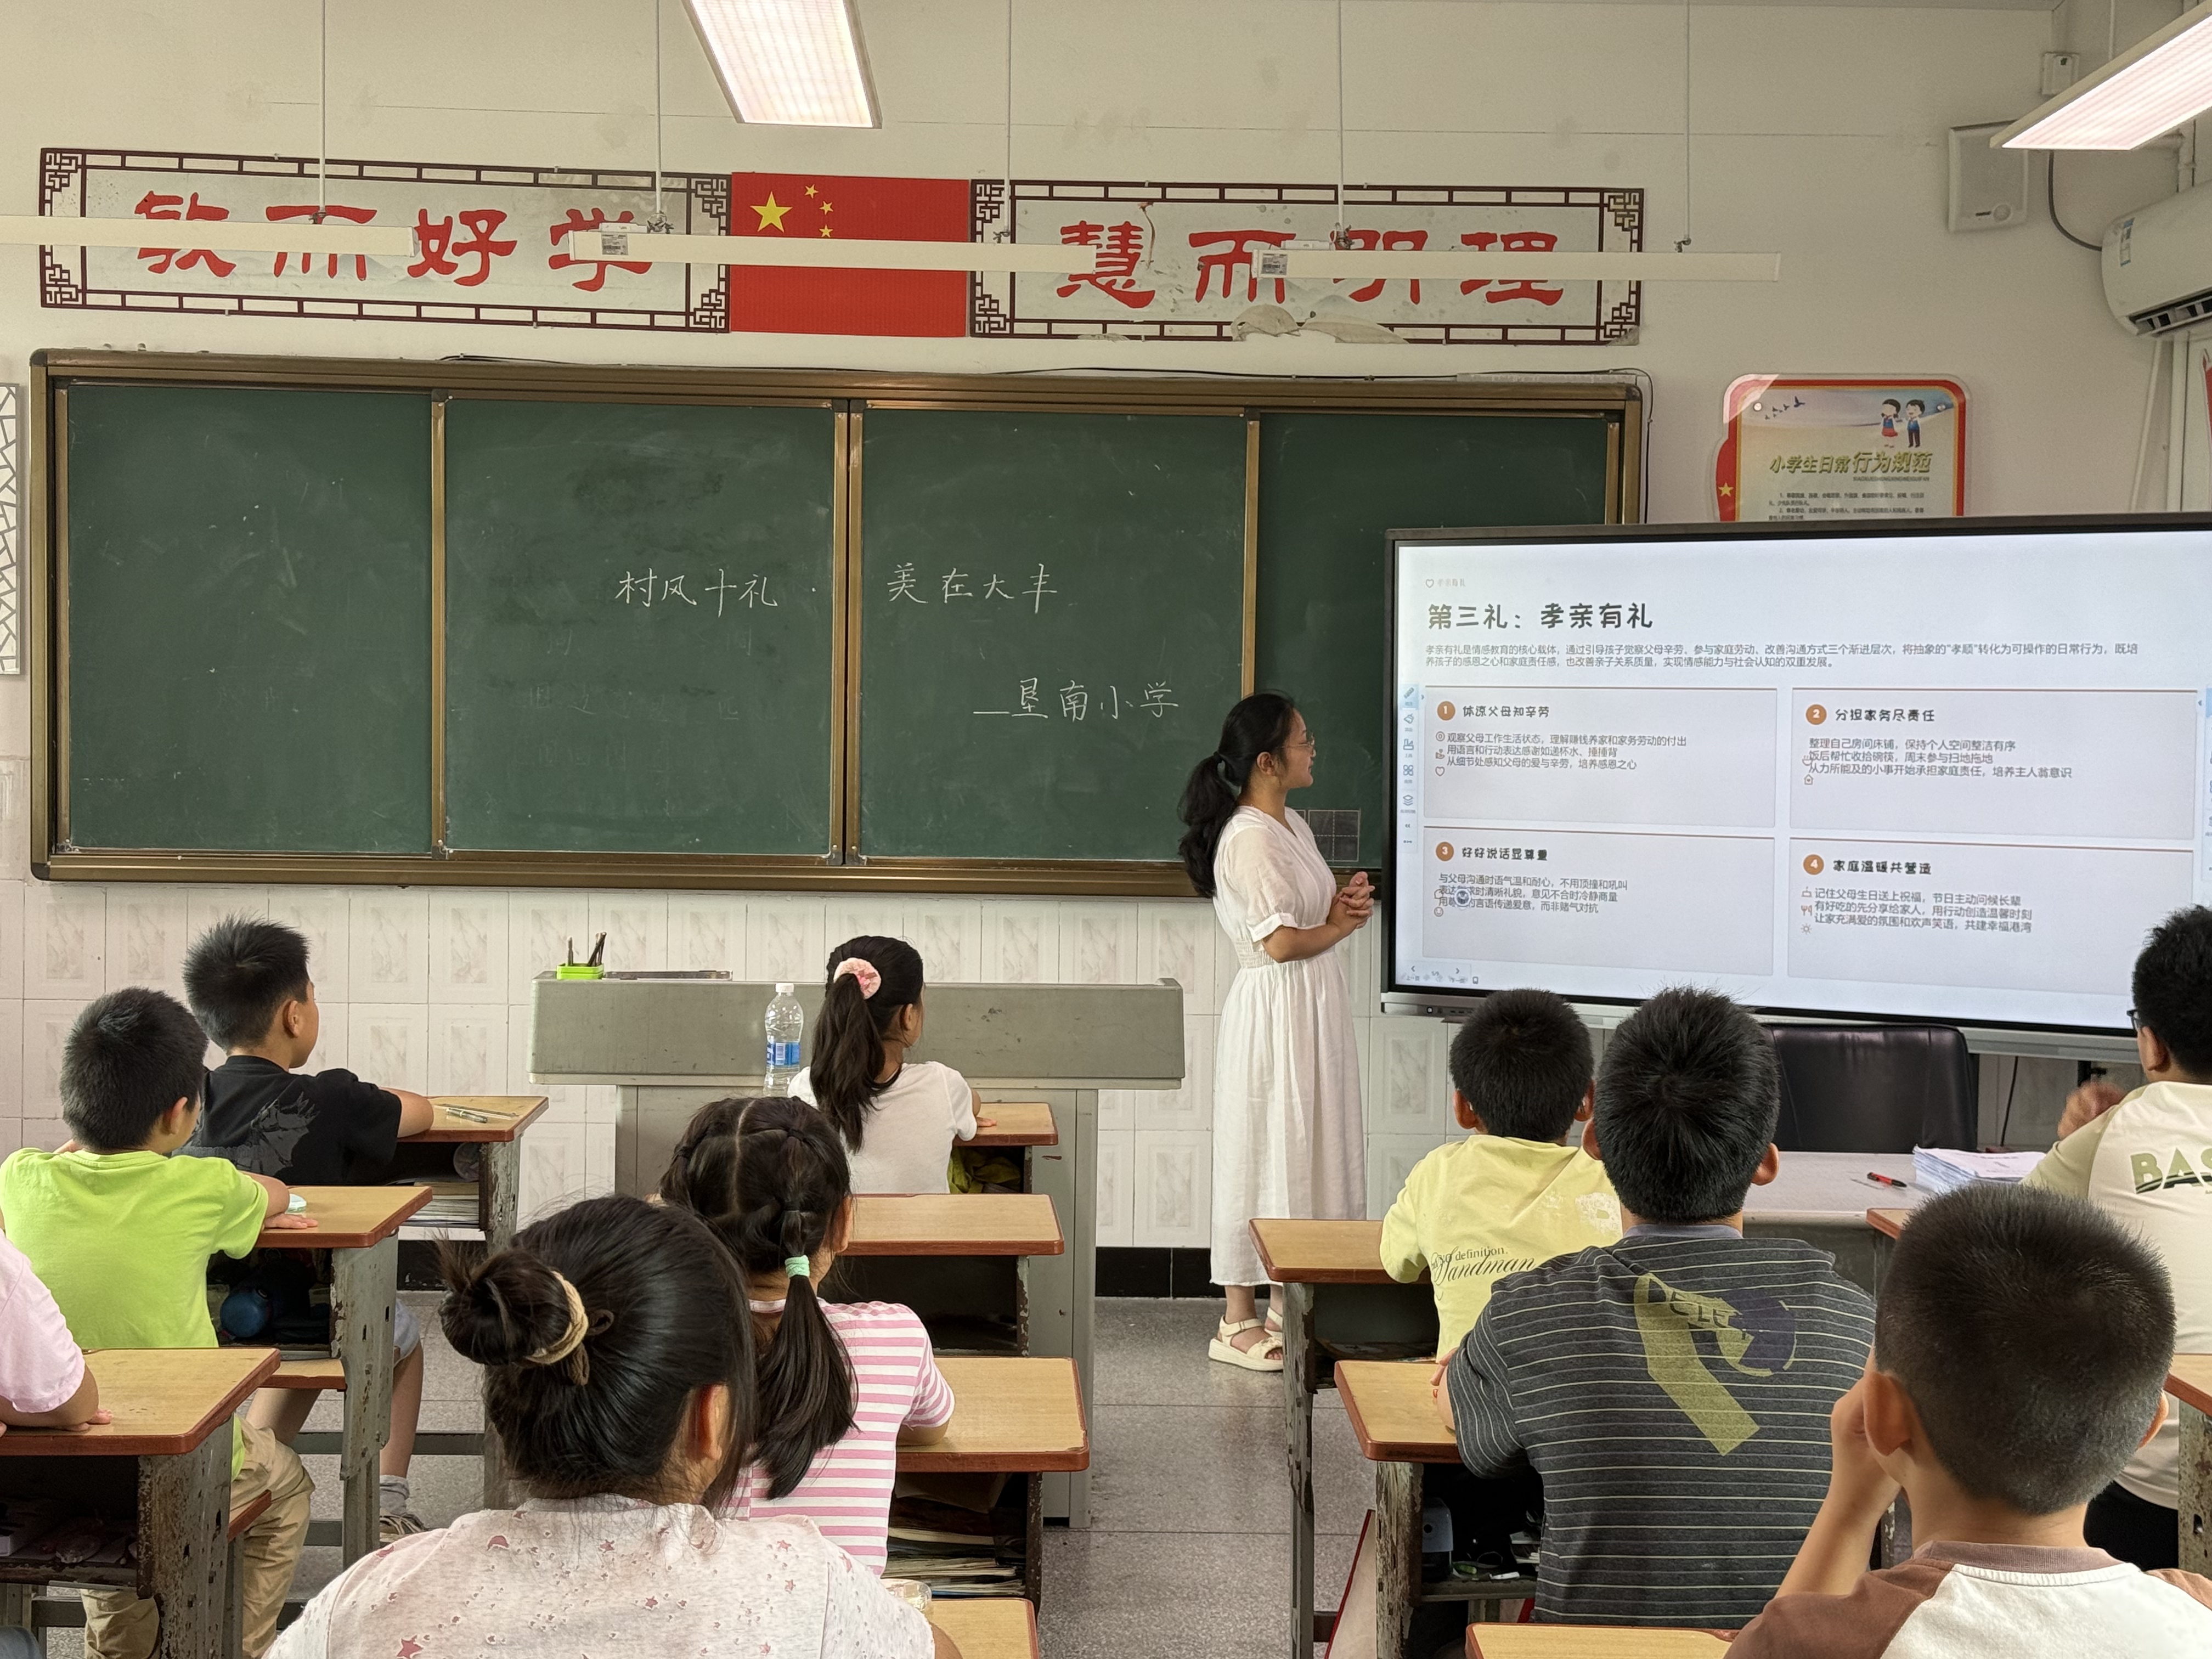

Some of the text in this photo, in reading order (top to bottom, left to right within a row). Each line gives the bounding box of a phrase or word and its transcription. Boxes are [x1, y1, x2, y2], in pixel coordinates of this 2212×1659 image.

[1770, 451, 1933, 474] 小学生日常行为规范
[614, 562, 1057, 618] 村风十礼 美在大丰
[1428, 602, 1653, 630] 第三礼：孝亲有礼
[1463, 705, 1550, 719] 体谅父母知辛劳
[1813, 709, 1820, 718] 2
[1835, 708, 1936, 722] 分担家务尽责任
[1810, 859, 1818, 869] 4
[1833, 859, 1932, 875] 家庭温暖共营造
